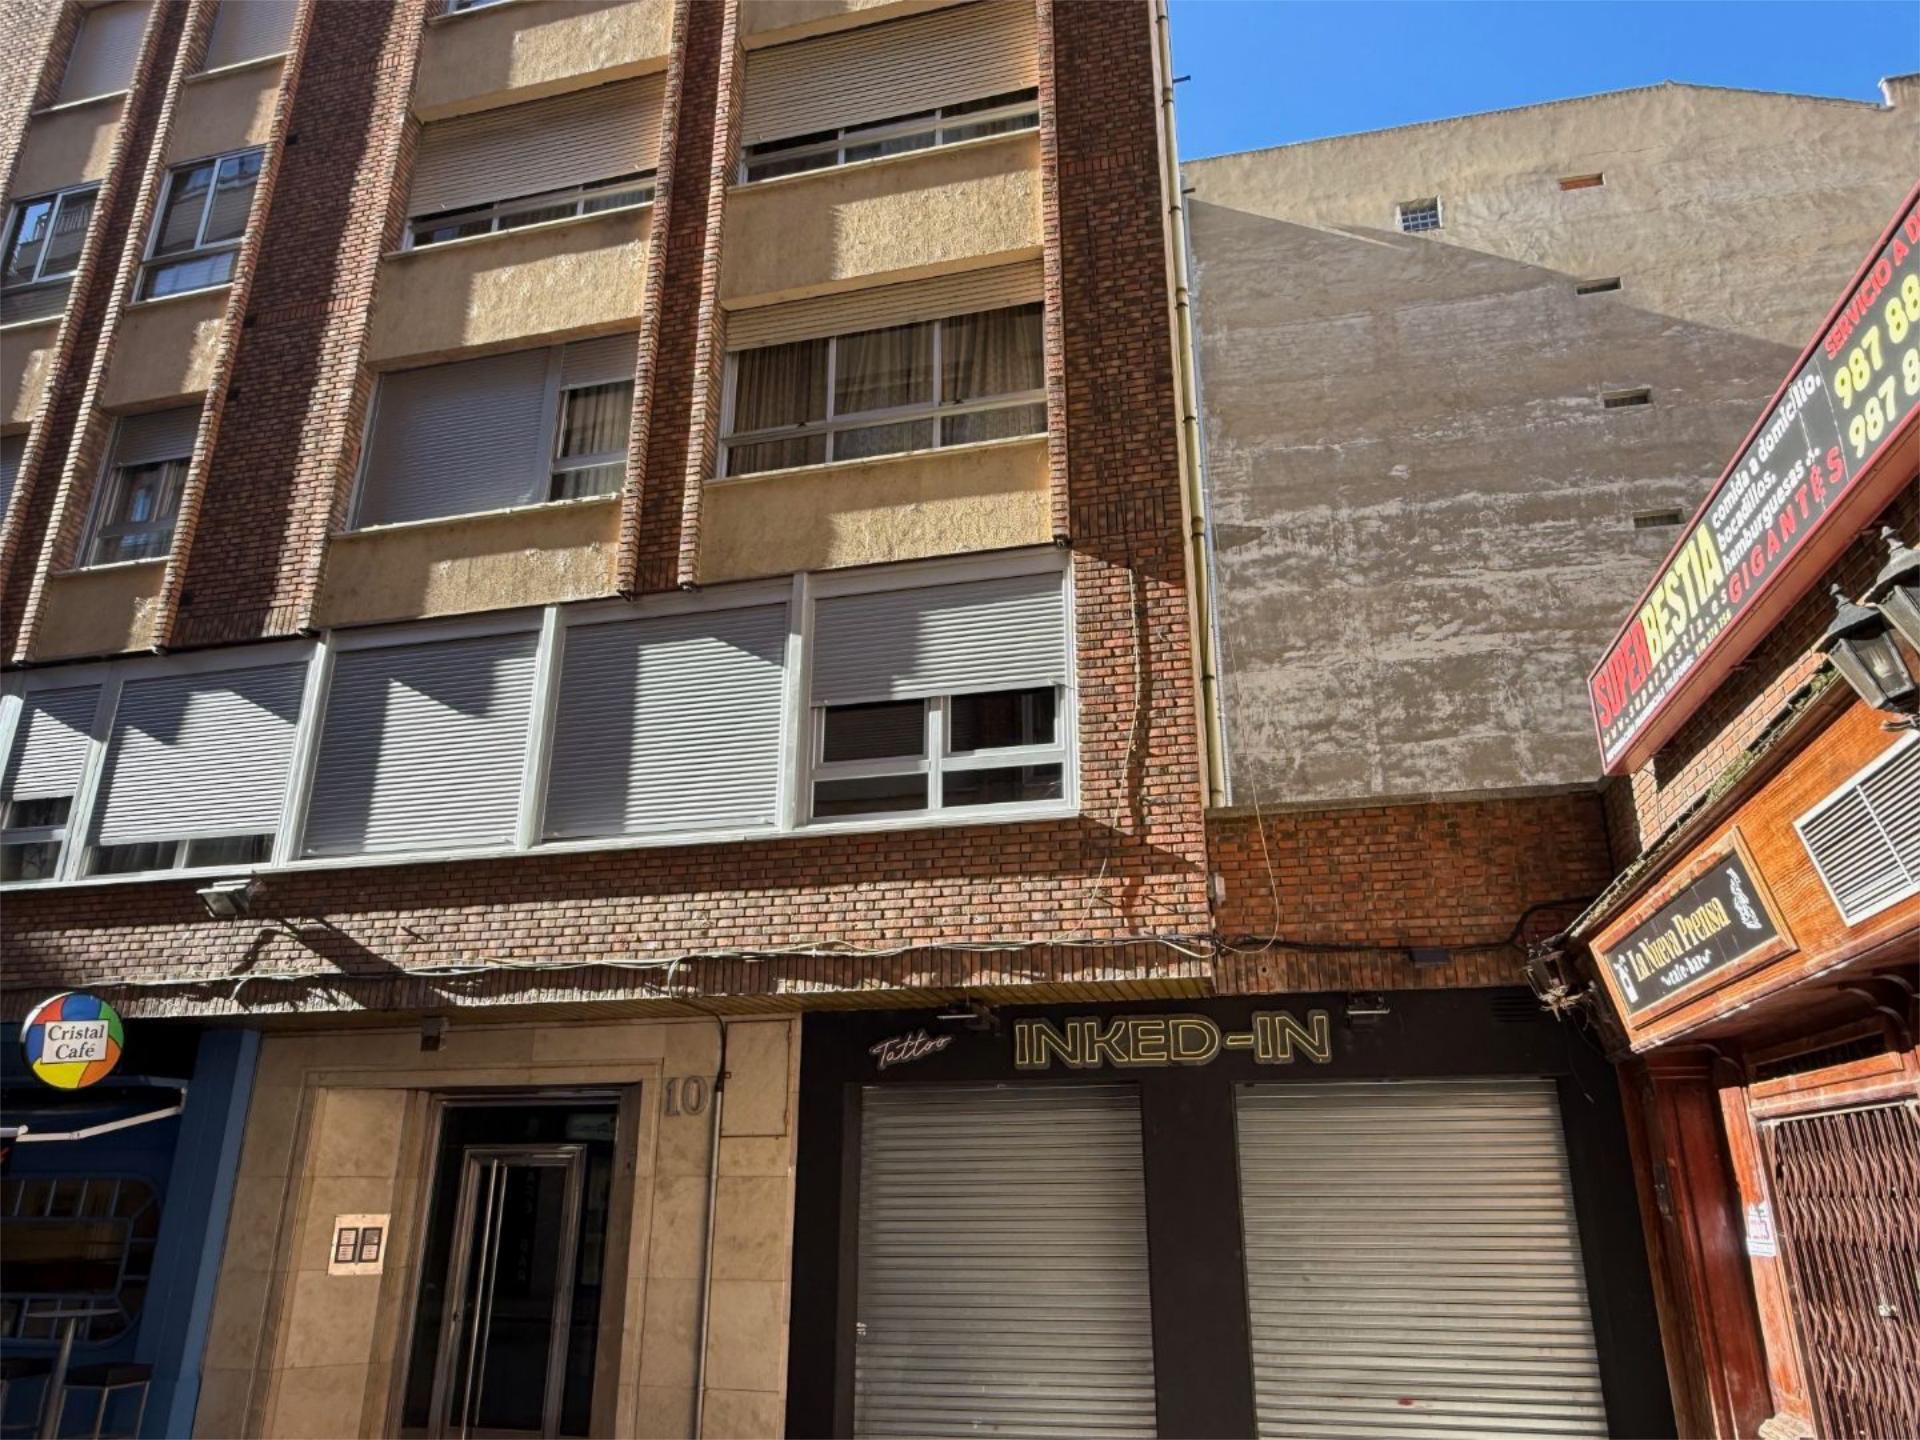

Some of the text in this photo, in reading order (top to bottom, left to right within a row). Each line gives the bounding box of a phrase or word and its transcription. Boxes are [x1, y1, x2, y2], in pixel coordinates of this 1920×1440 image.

[1824, 201, 1920, 360] SERVICIO A D
[1834, 325, 1883, 410] 987
[1849, 374, 1896, 459] 987
[1712, 469, 1750, 529] comida
[1748, 457, 1760, 477] a
[1728, 446, 1845, 604] GIGANTES
[1626, 896, 1731, 982] La Nueva Prensa
[48, 1023, 105, 1042] Cristal
[55, 1042, 95, 1060] Café
[870, 1031, 954, 1067] Tattoo
[1013, 1012, 1332, 1067] INKED-IN
[664, 1074, 709, 1117] 10
